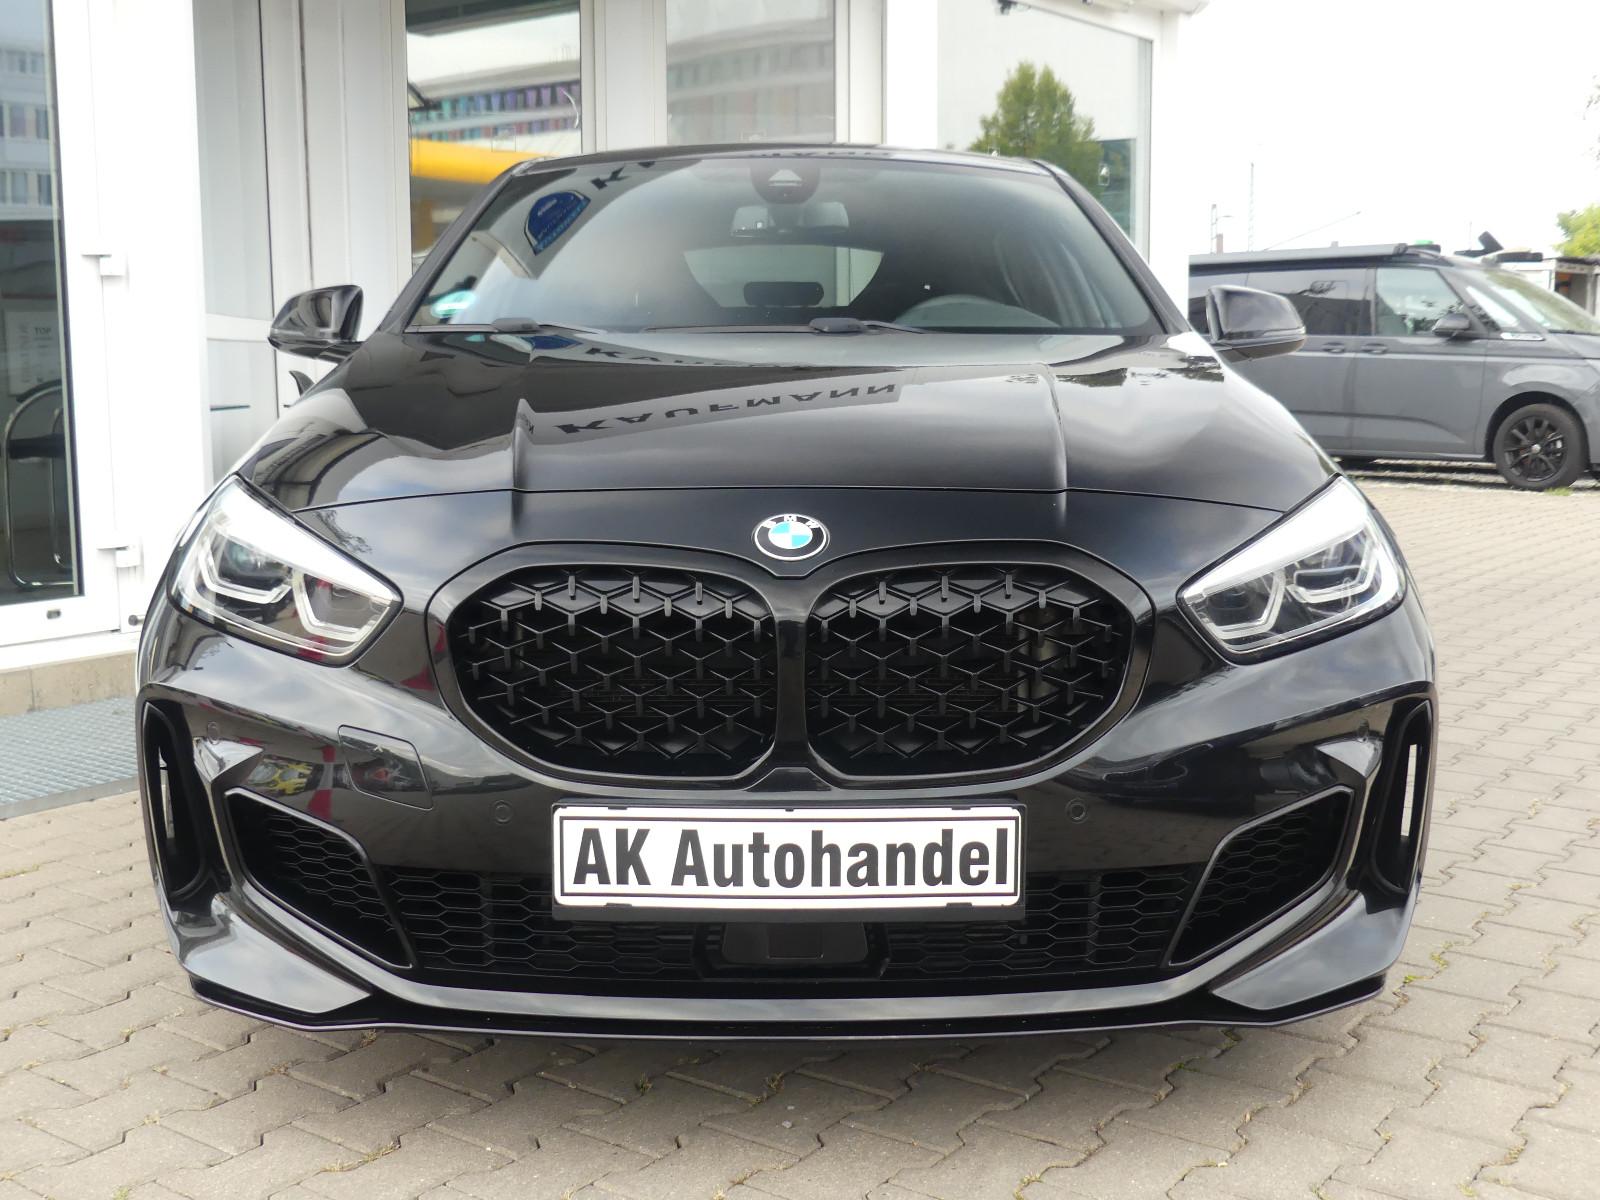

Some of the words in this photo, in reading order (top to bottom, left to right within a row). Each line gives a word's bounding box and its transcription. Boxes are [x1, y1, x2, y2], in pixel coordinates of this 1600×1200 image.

[761, 514, 821, 529] BMW
[573, 828, 651, 886] AK
[671, 828, 1008, 887] Autohandel
